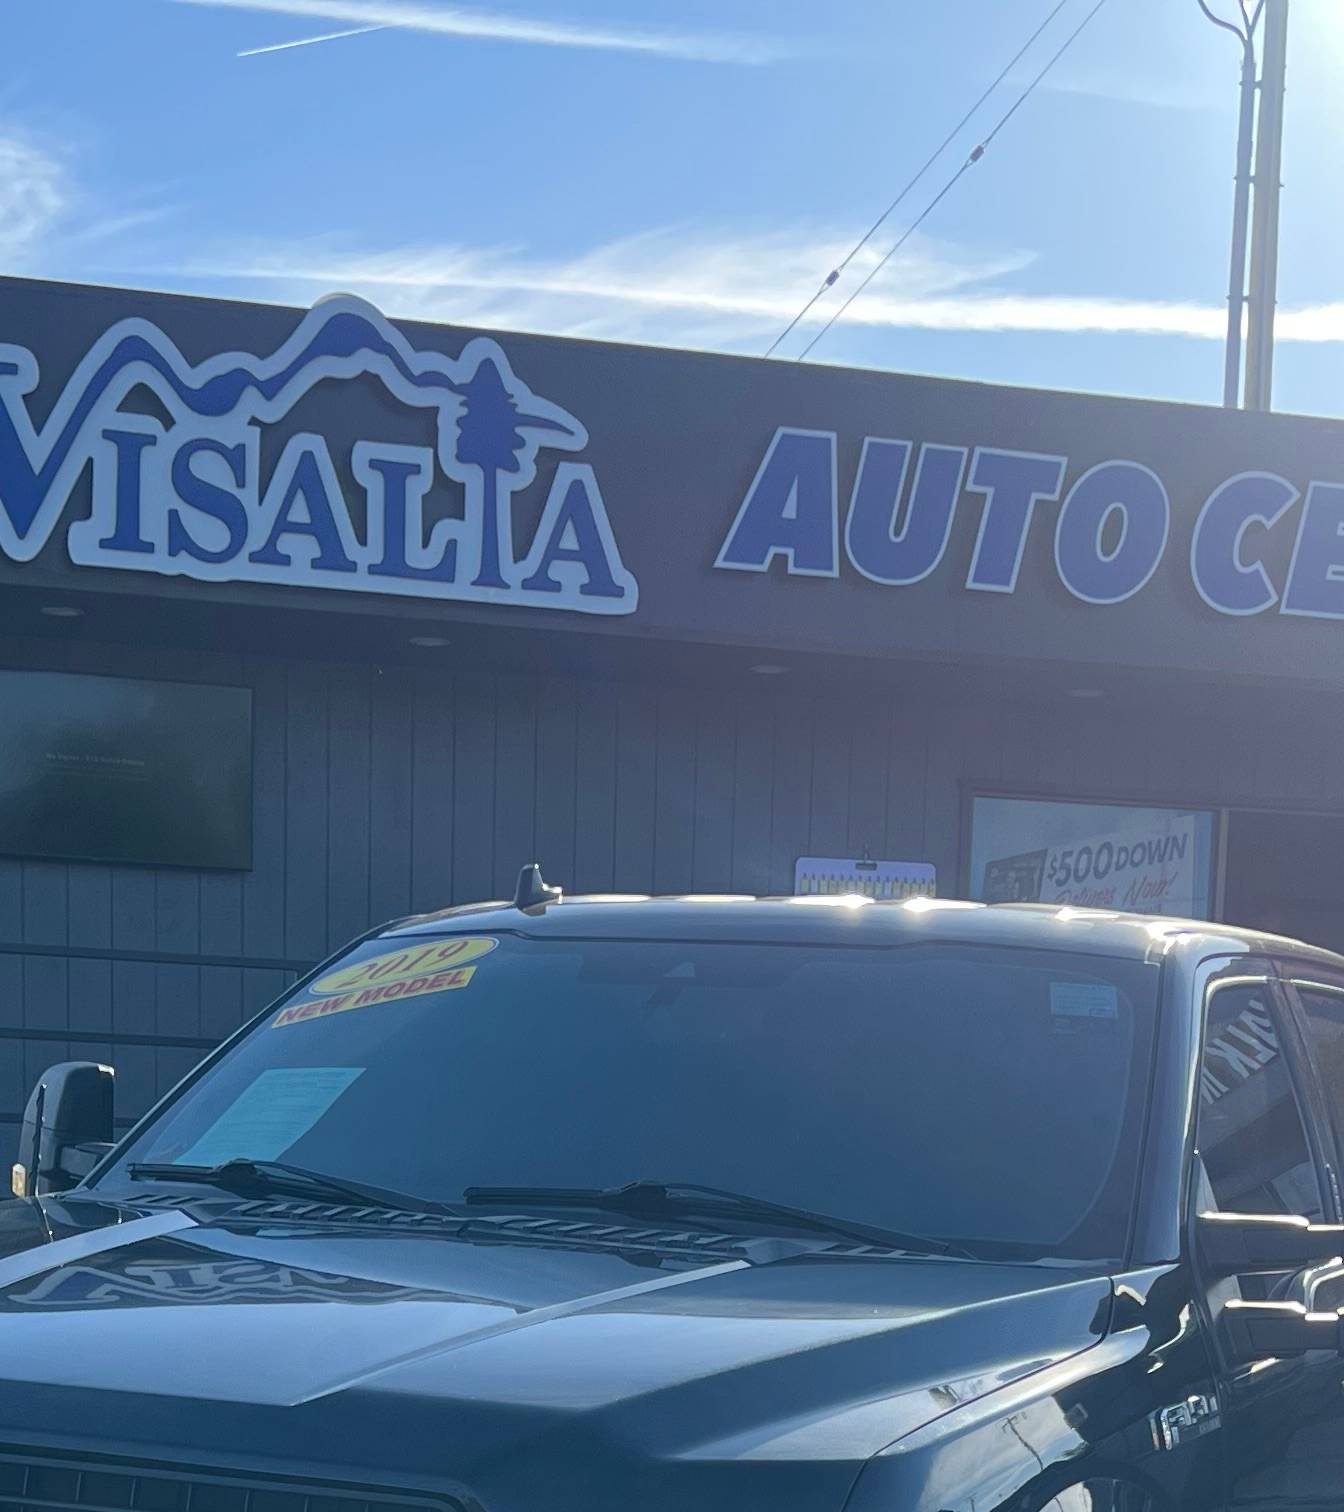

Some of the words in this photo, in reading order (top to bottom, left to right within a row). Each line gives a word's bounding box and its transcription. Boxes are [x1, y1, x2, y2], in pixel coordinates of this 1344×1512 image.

[712, 425, 1171, 604] AUTO
[1047, 841, 1113, 888] $500
[1114, 832, 1188, 872] DOWN
[333, 940, 470, 989] 2019
[276, 993, 347, 1026] NEW
[352, 967, 468, 1005] MODEL
